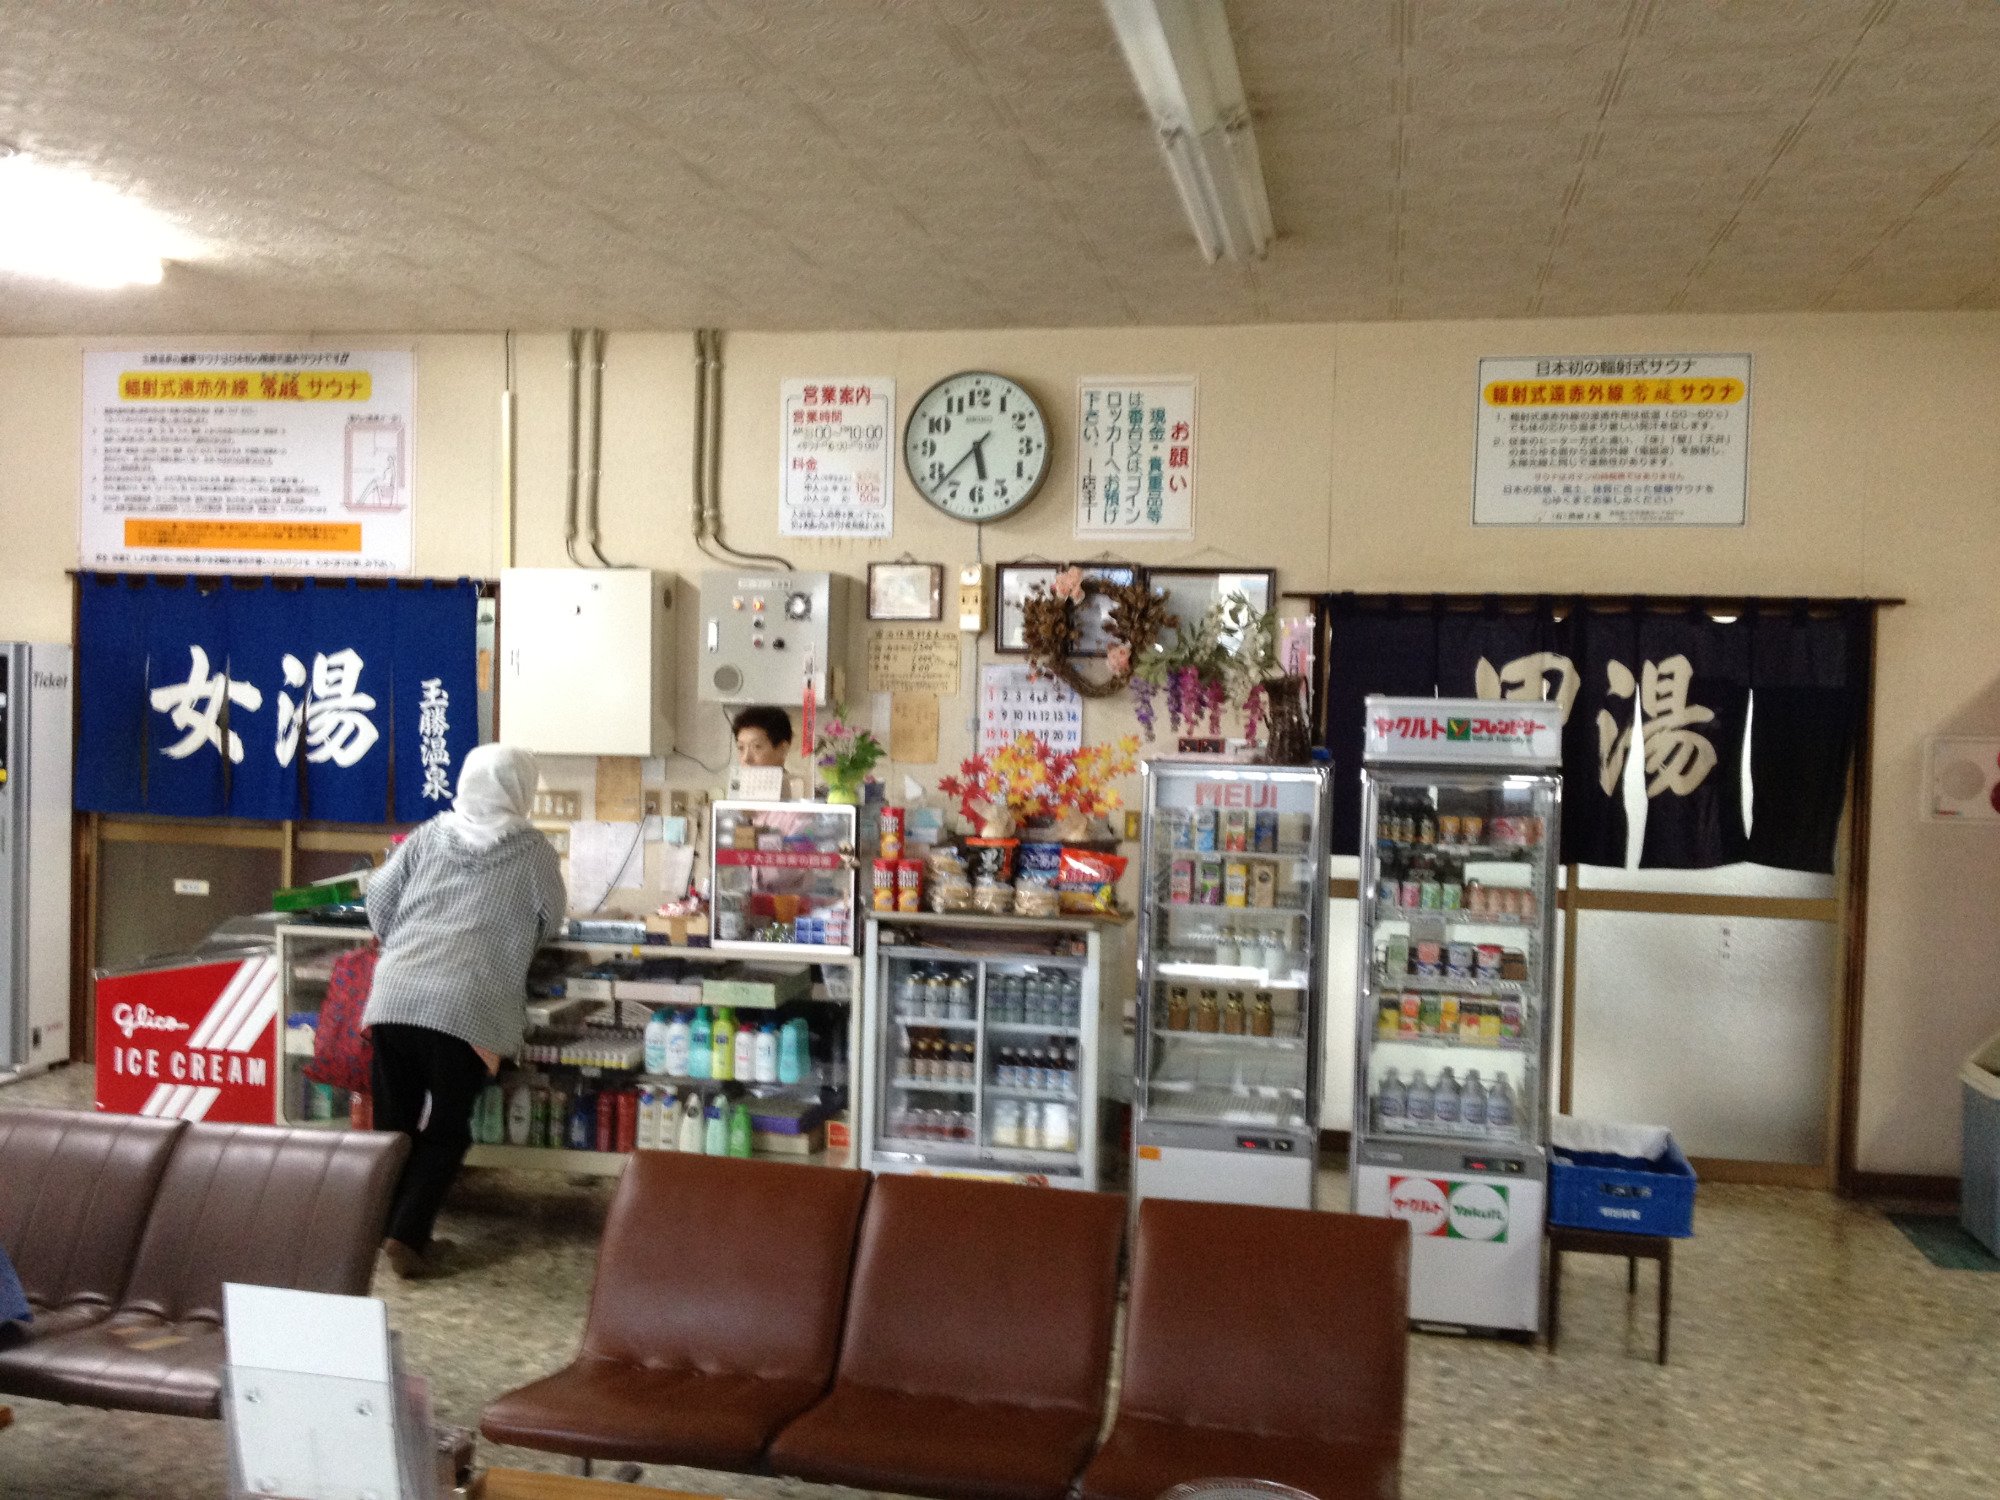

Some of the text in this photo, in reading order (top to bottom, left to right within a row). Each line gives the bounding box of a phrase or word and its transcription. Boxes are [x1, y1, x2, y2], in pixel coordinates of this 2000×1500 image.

[308, 377, 363, 398] サウナ
[803, 385, 871, 405] 営業案内
[1680, 384, 1735, 402] サウナ
[947, 396, 964, 413] 11
[968, 388, 991, 408] 12
[1000, 395, 1007, 412] 1
[793, 410, 843, 425] 営業時間
[929, 416, 951, 433] 10
[1012, 411, 1026, 431] 2
[922, 439, 937, 457] 9
[1019, 437, 1033, 456] 3
[792, 457, 817, 471] 料金
[1169, 421, 1190, 492] お願い
[949, 479, 961, 498] 7
[969, 485, 984, 503] 6
[994, 478, 1008, 497] 5
[33, 672, 68, 689] Ticket
[150, 645, 380, 768] 女湯
[1014, 710, 1023, 721] 10
[1027, 711, 1036, 721] 11
[1374, 716, 1547, 740] ヤクルト フレンドリー
[420, 677, 454, 801] 玉勝温泉
[1195, 782, 1278, 808] MEIJI
[112, 1002, 190, 1039] Glico
[113, 1046, 267, 1086] ICE CREAM
